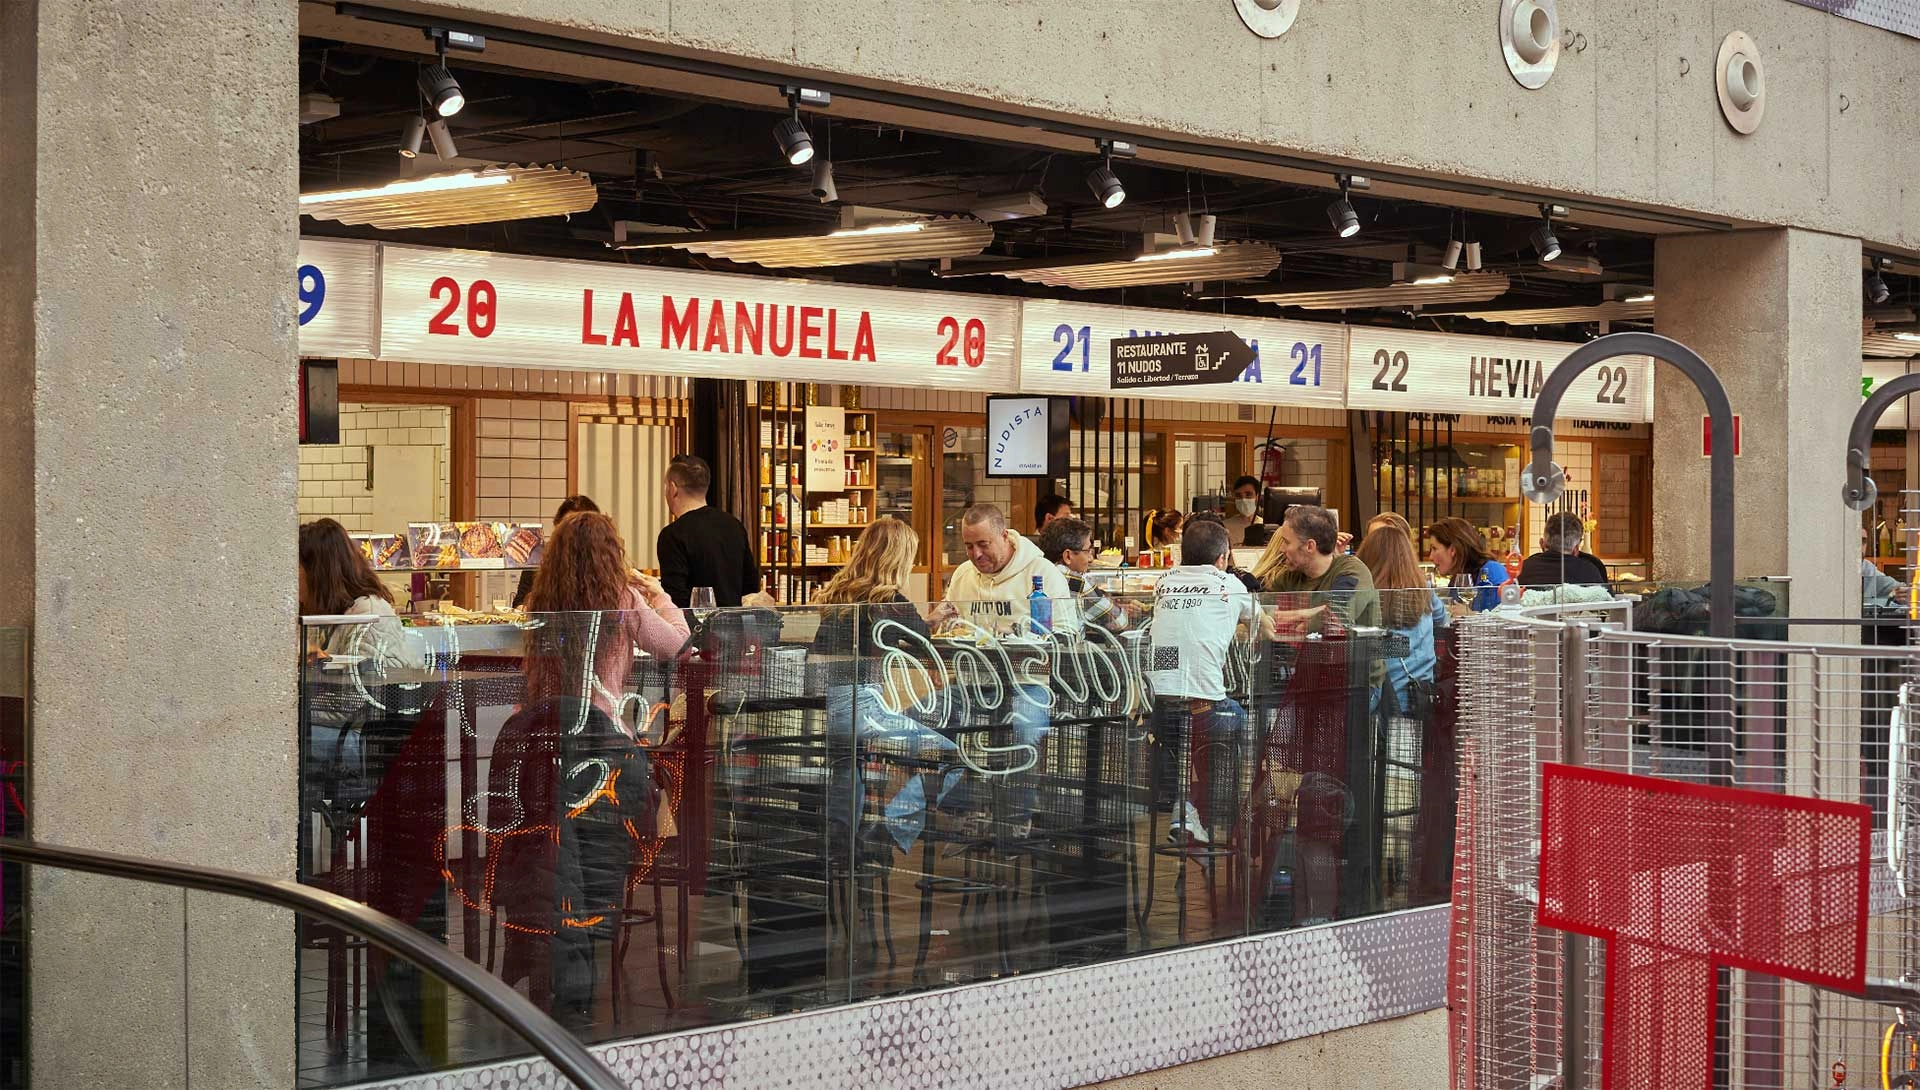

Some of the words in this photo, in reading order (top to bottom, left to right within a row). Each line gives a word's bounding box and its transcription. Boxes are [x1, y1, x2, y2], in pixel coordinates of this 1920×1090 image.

[428, 276, 497, 339] 20
[582, 288, 640, 348] LA
[661, 294, 877, 363] MANUELA
[936, 316, 986, 368] 20
[1052, 323, 1092, 373] 21
[1116, 341, 1187, 359] RESTAURANTE
[1289, 341, 1322, 387] 21
[1116, 361, 1126, 375] 11
[1127, 360, 1162, 374] NUDOS
[1116, 376, 1137, 384] Salida
[1143, 374, 1170, 383] Libertad
[1371, 348, 1409, 393] 22
[1468, 356, 1545, 399] HEVIA
[1596, 365, 1628, 405] 22
[994, 406, 1043, 468] NUDISTA
[1486, 415, 1517, 426] PASTA
